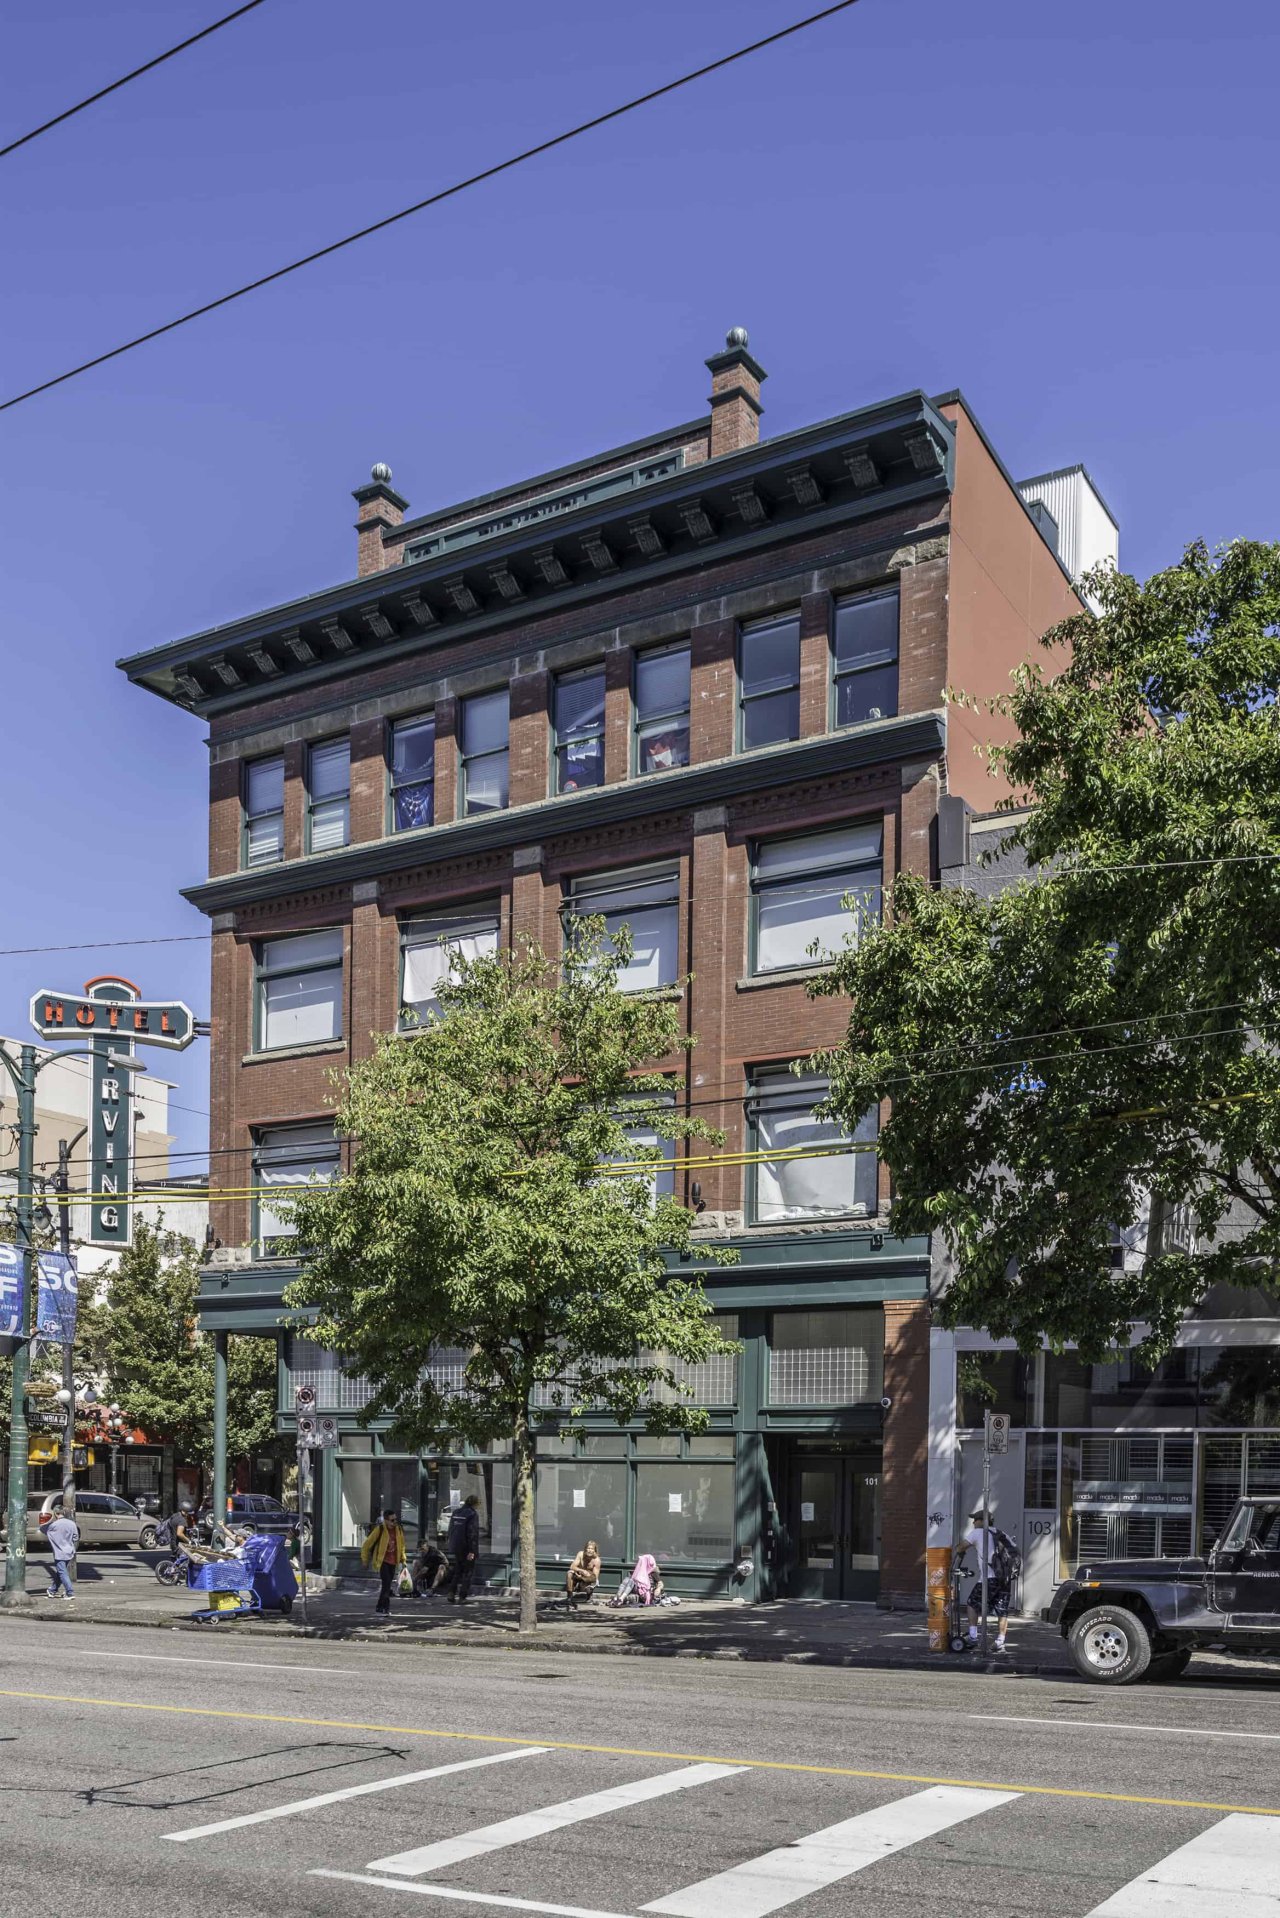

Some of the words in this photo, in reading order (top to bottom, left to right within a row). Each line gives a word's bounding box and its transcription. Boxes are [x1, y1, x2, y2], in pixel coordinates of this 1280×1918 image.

[45, 1001, 176, 1033] HOTEL
[864, 1477, 878, 1485] 101
[1027, 1521, 1052, 1535] 103
